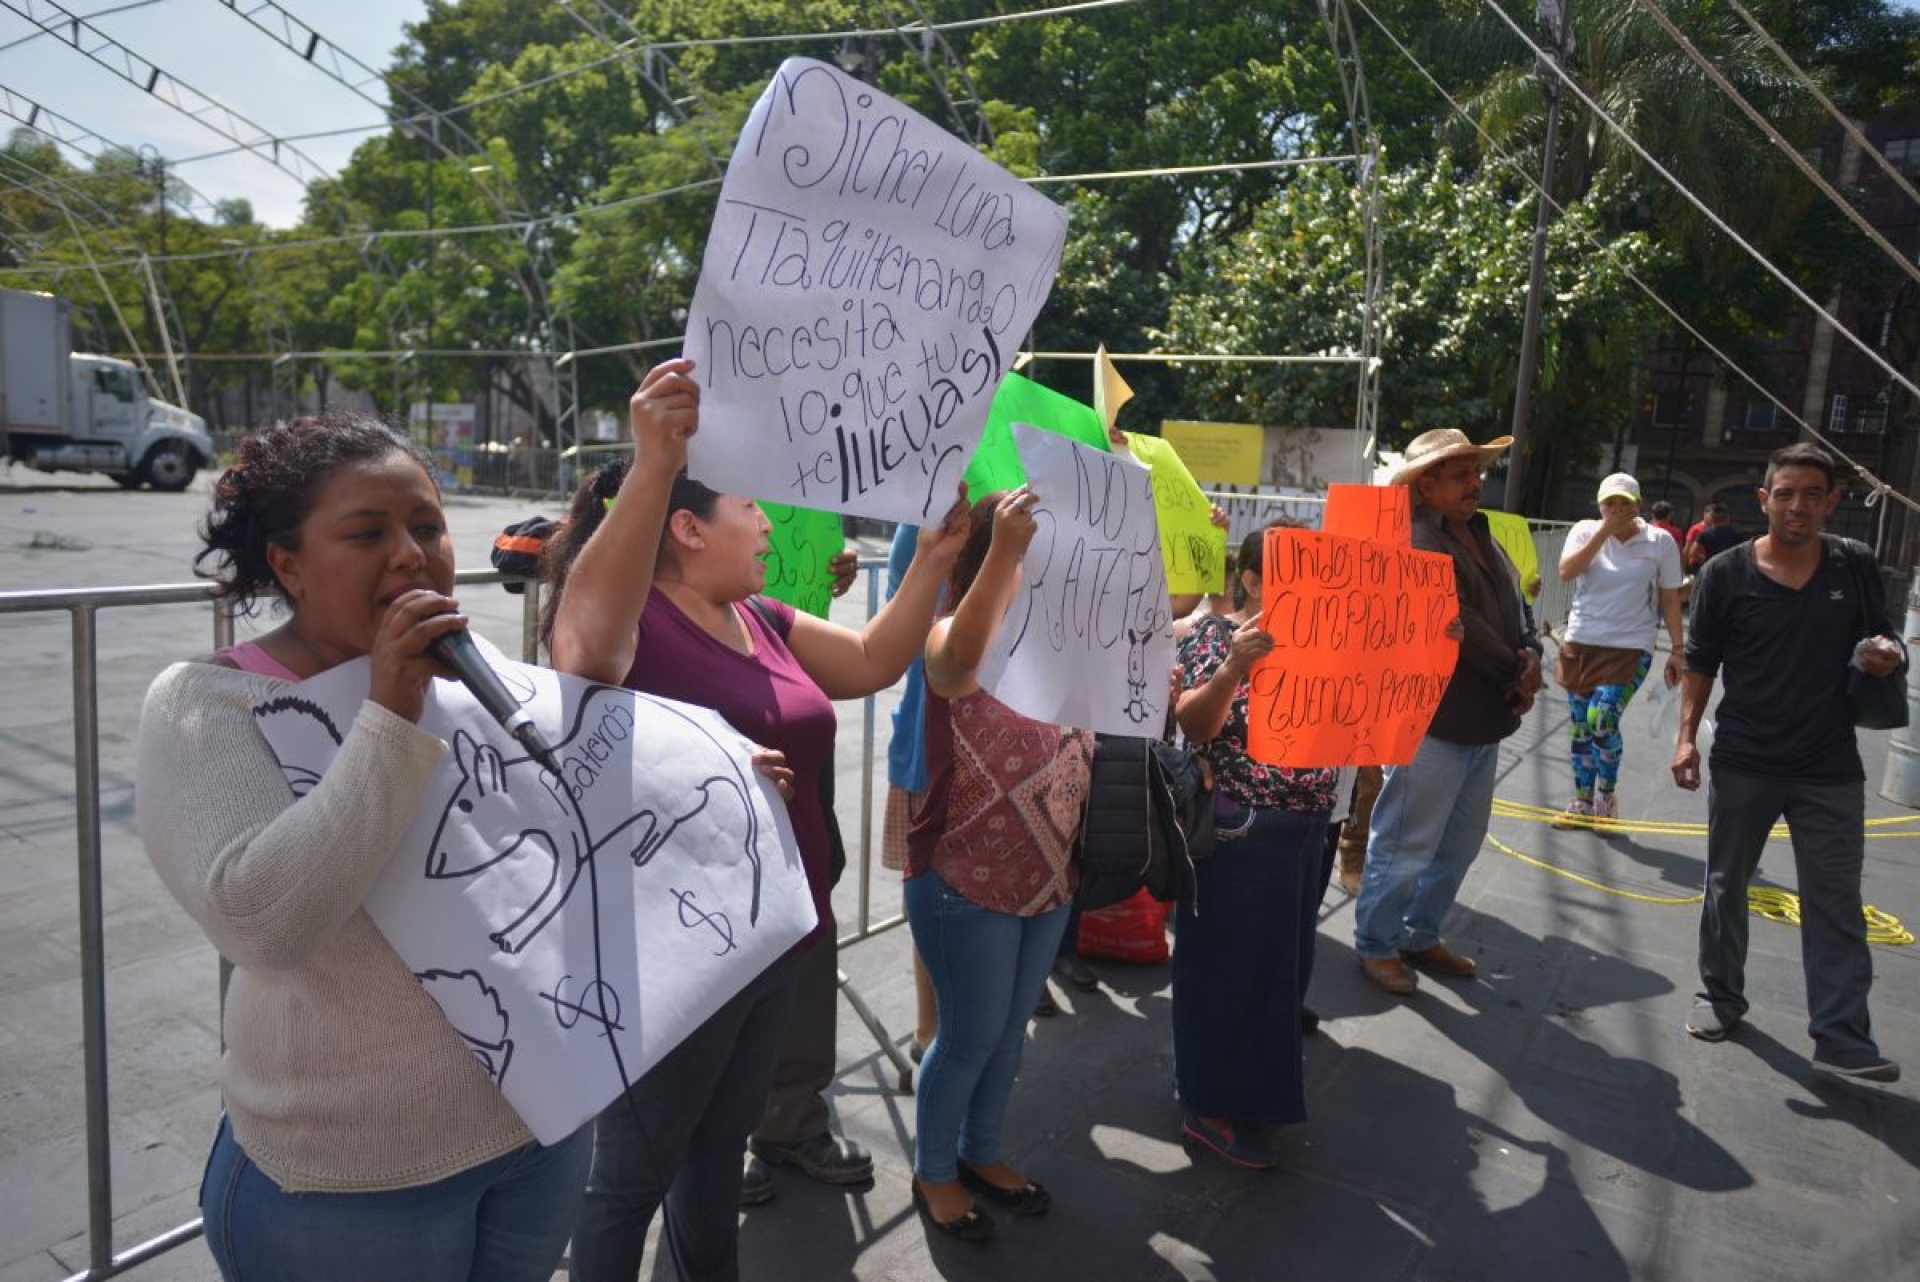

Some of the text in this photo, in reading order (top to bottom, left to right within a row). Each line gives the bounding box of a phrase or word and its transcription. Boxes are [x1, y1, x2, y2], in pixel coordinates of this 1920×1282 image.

[706, 298, 906, 389] necesita
[842, 361, 907, 427] que
[916, 332, 958, 387] tu
[1071, 441, 1127, 541] NO
